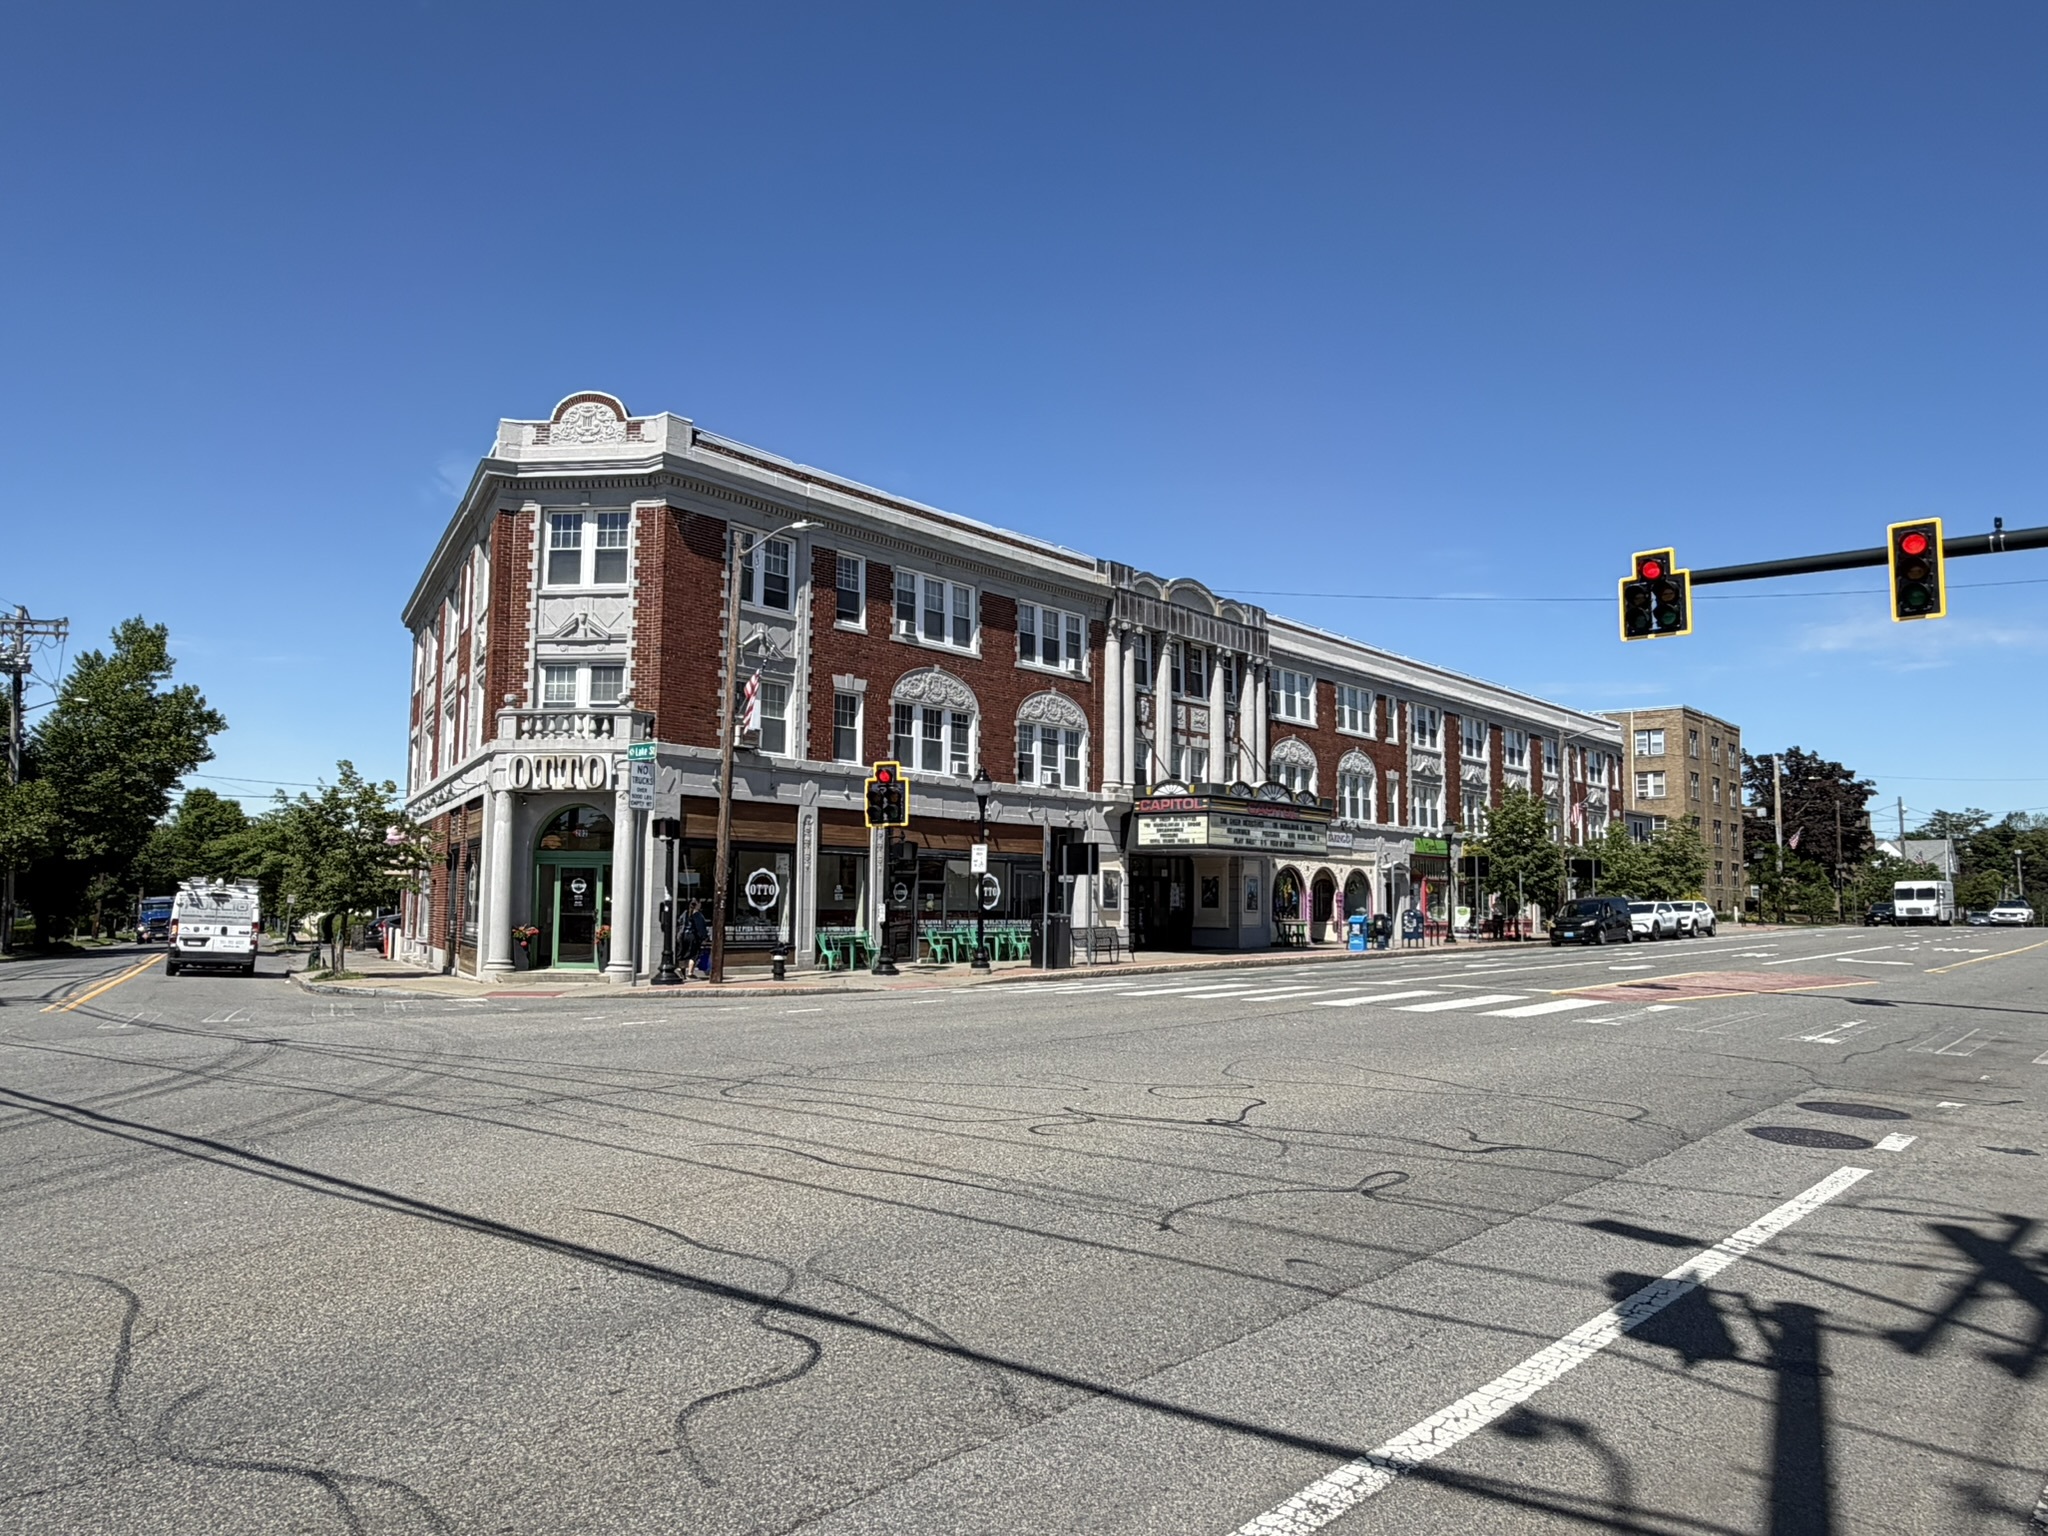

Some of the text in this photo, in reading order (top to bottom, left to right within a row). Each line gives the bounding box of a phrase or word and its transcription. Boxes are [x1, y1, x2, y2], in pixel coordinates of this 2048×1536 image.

[635, 747, 648, 756] Lake
[509, 755, 606, 789] OTTO
[637, 765, 649, 775] NO
[632, 776, 654, 785] TRUCKS
[1140, 798, 1202, 811] CAPITOL
[750, 884, 775, 895] OTTO
